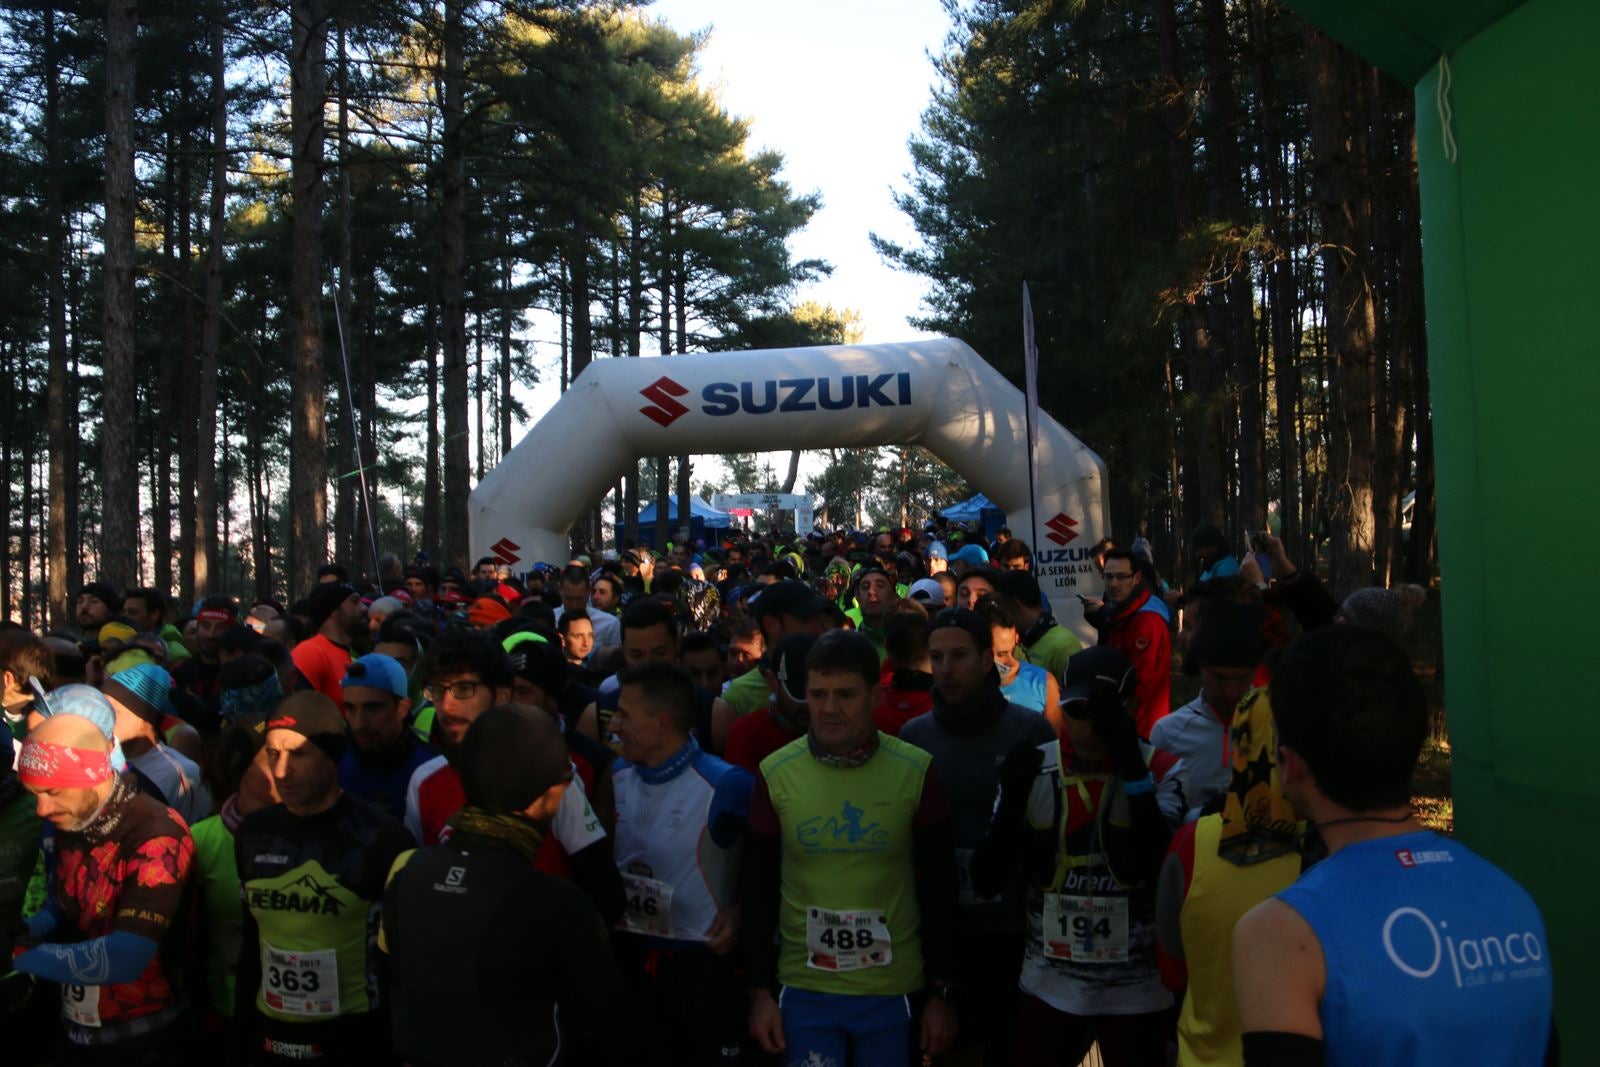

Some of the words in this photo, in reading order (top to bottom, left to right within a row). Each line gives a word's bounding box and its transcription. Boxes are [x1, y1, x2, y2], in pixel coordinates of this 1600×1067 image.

[702, 373, 911, 416] SUZUKI
[1049, 565, 1077, 576] SERNA
[623, 894, 657, 915] 46
[1058, 915, 1111, 938] 194
[820, 928, 874, 949] 488
[1382, 906, 1542, 988] Ojanco
[268, 965, 320, 992] 363
